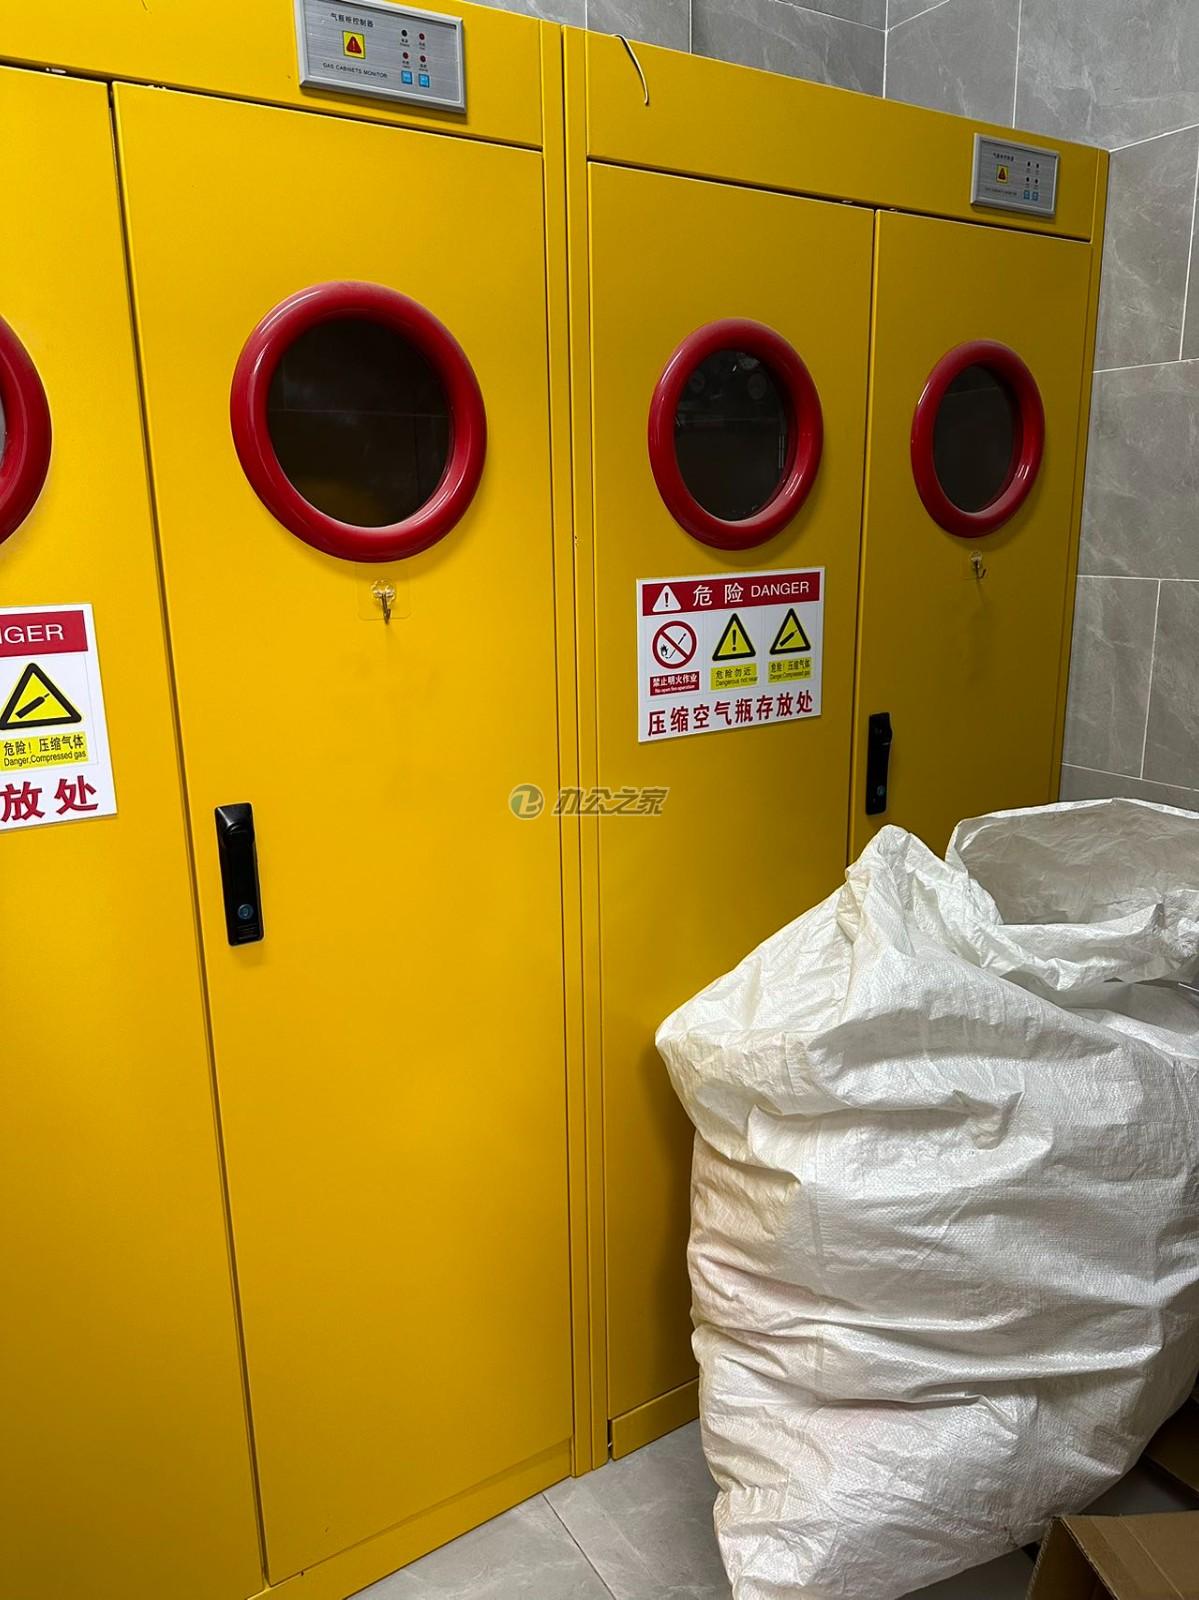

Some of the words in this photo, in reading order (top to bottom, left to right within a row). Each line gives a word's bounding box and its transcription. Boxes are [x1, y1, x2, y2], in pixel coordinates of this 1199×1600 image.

[693, 583, 744, 607] 危险
[751, 581, 809, 598] DANGER
[0, 623, 65, 645] GER
[652, 673, 697, 688] 禁止明火作业
[716, 666, 752, 680] 危险勿近
[648, 690, 813, 737] 压缩空气瓶存放处
[74, 750, 87, 761] gas
[0, 775, 99, 823] 放处
